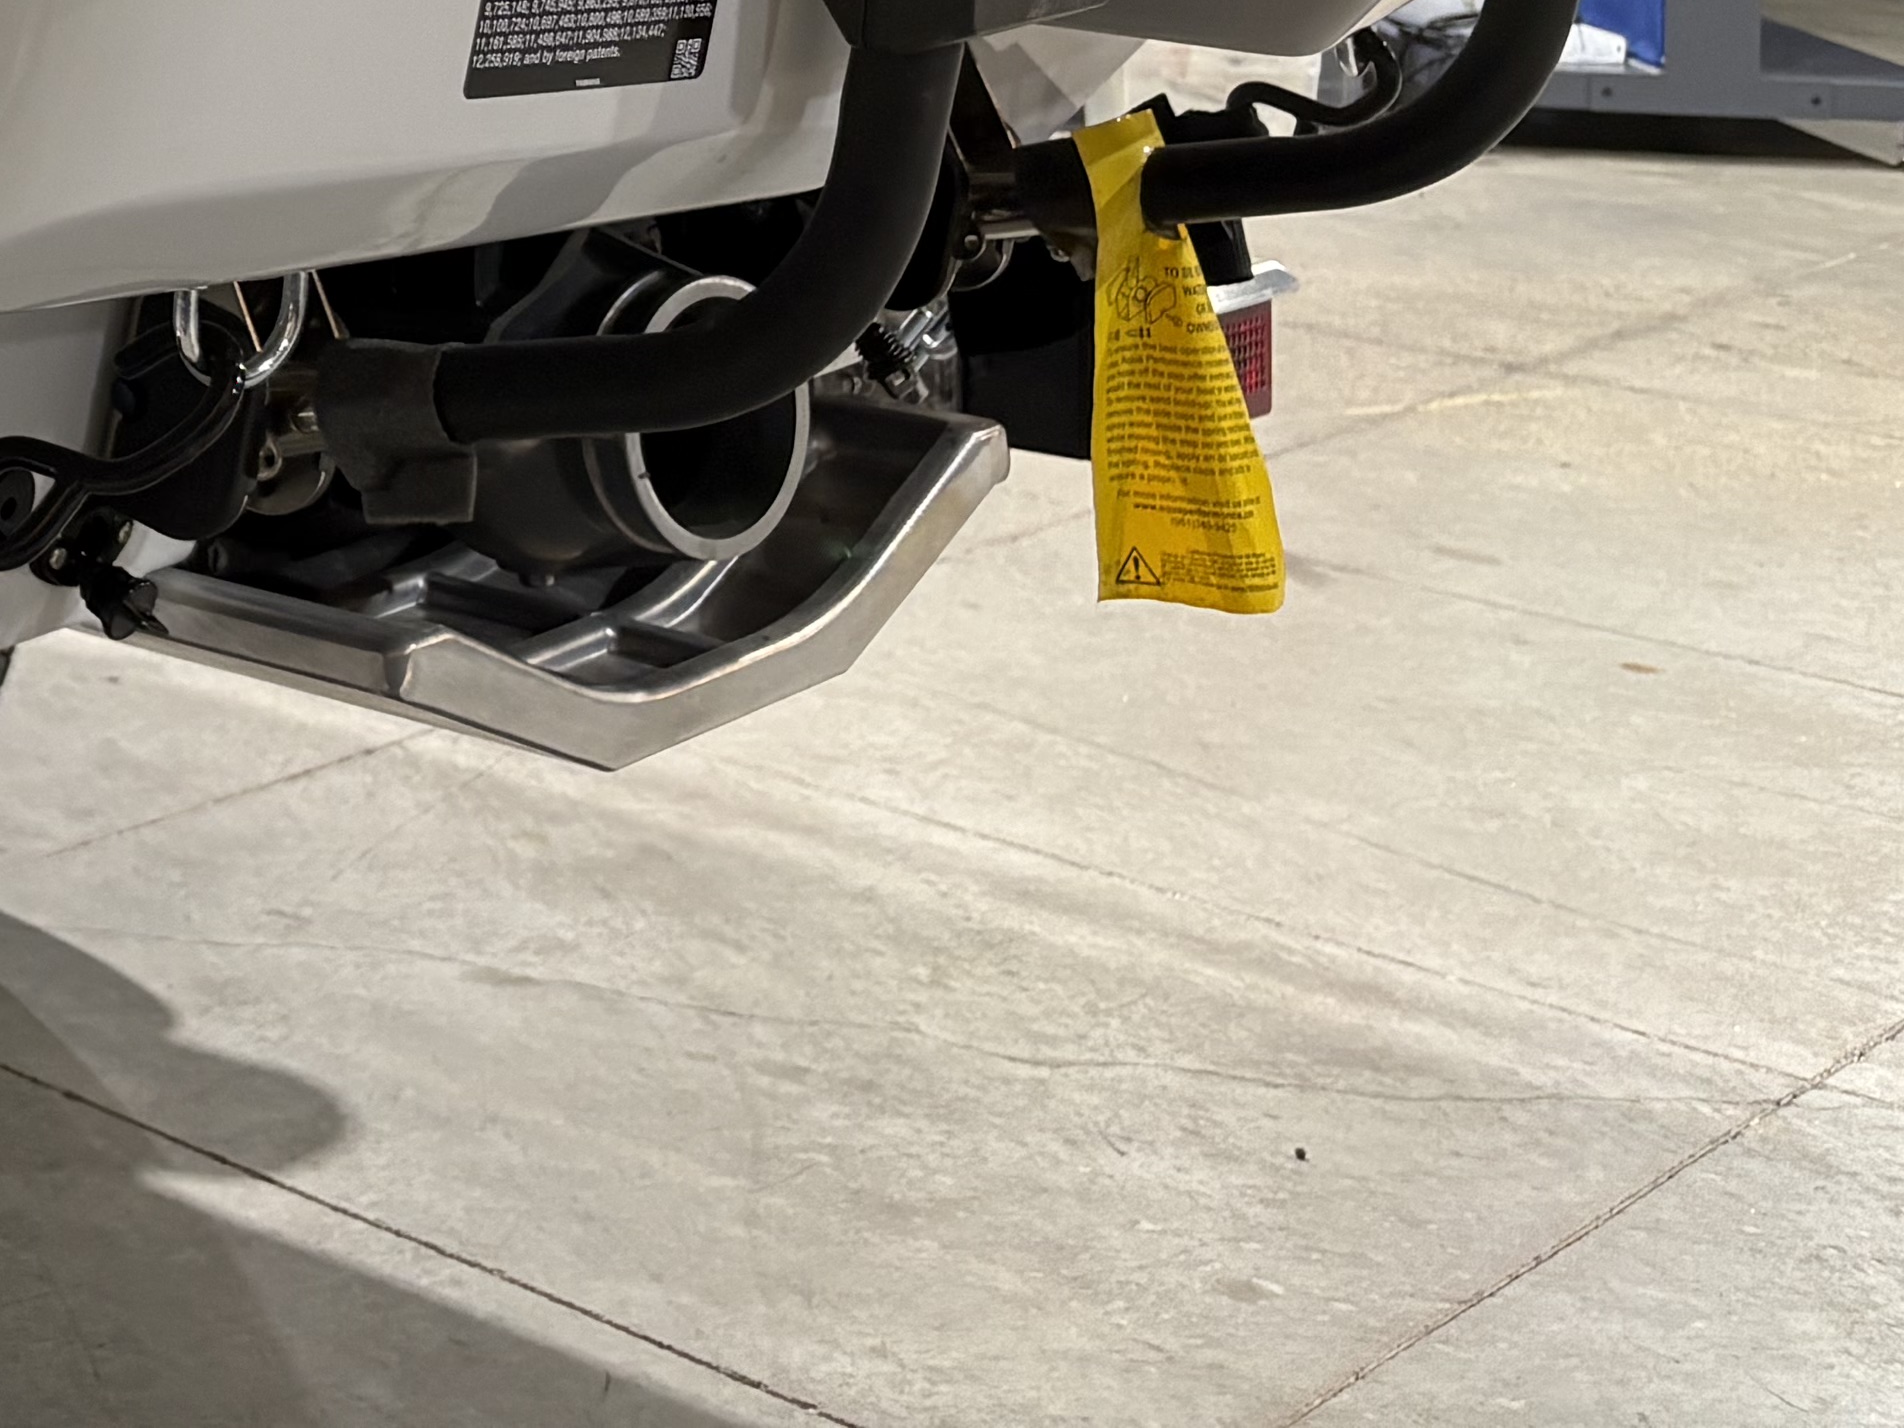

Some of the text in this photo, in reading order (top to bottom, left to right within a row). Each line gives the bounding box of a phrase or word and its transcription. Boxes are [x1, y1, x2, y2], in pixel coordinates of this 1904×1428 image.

[522, 51, 541, 65] and
[541, 50, 554, 65] by
[553, 47, 586, 64] foreign
[585, 44, 622, 61] patents.
